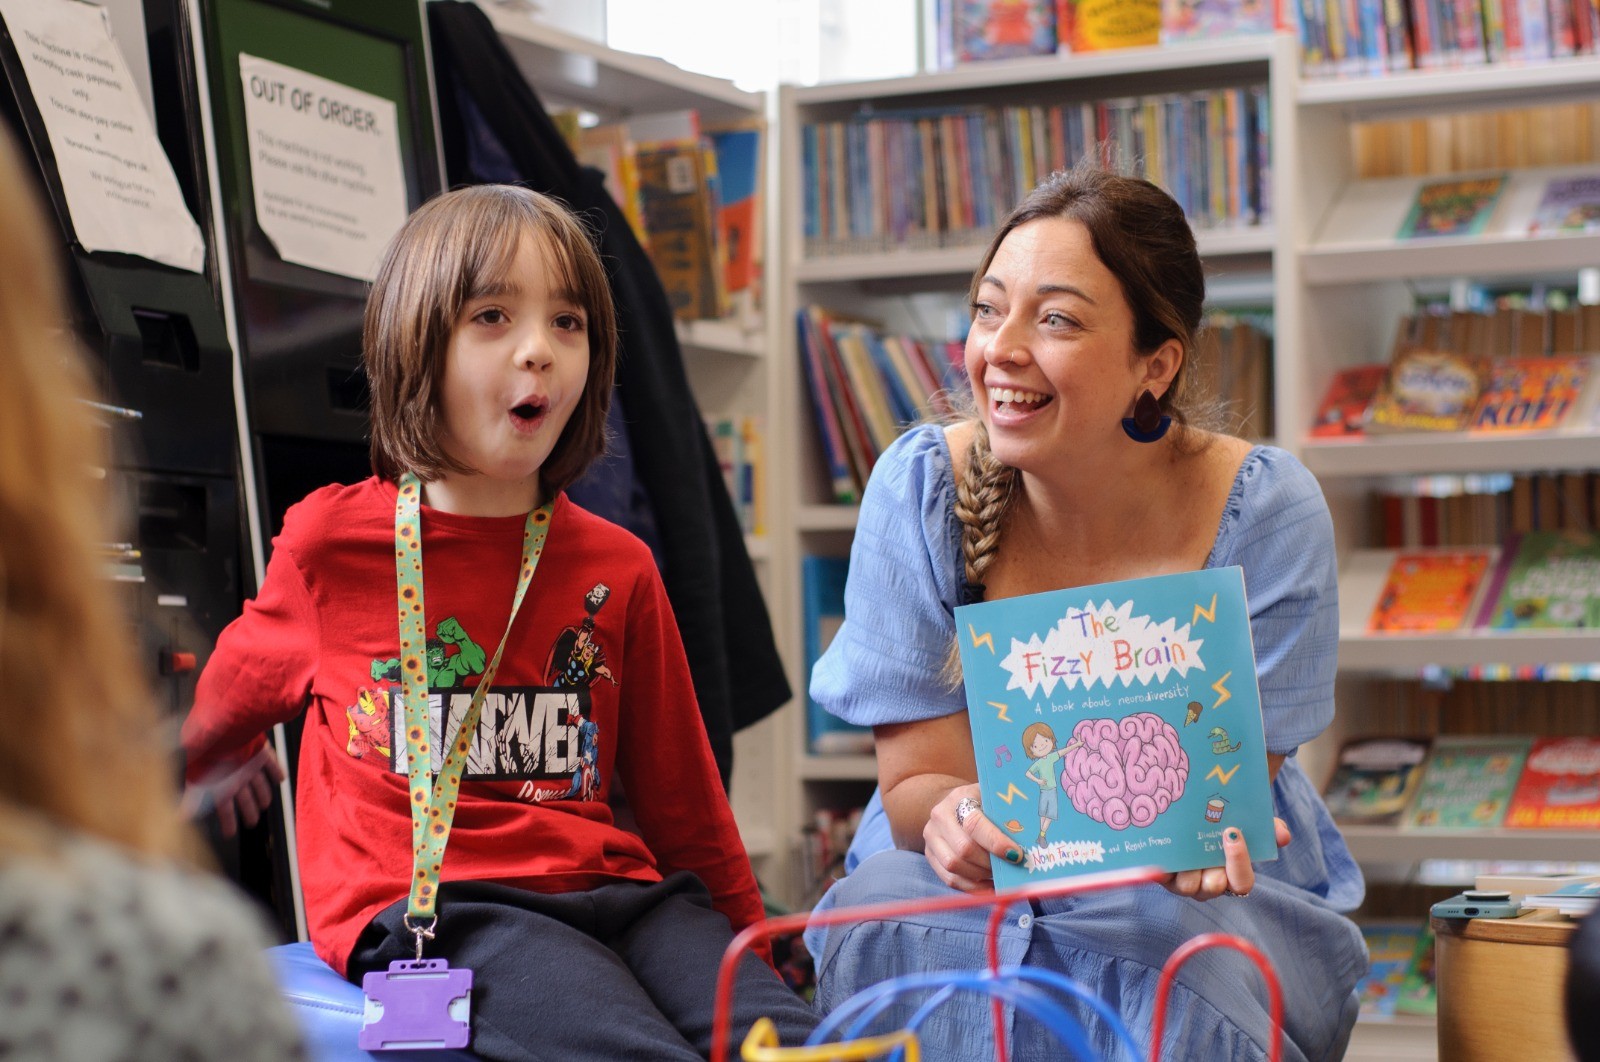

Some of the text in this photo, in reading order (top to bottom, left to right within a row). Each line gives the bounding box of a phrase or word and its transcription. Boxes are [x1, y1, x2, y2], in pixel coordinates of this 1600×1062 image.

[250, 75, 382, 137] OUT OF ORDER.
[1071, 612, 1120, 638] The
[1022, 636, 1186, 683] Fizzy Brain
[1035, 682, 1190, 715] A book about neurodiversity
[1197, 828, 1223, 840] Illustra
[1056, 844, 1080, 860] Faria
[1109, 843, 1120, 854] and
